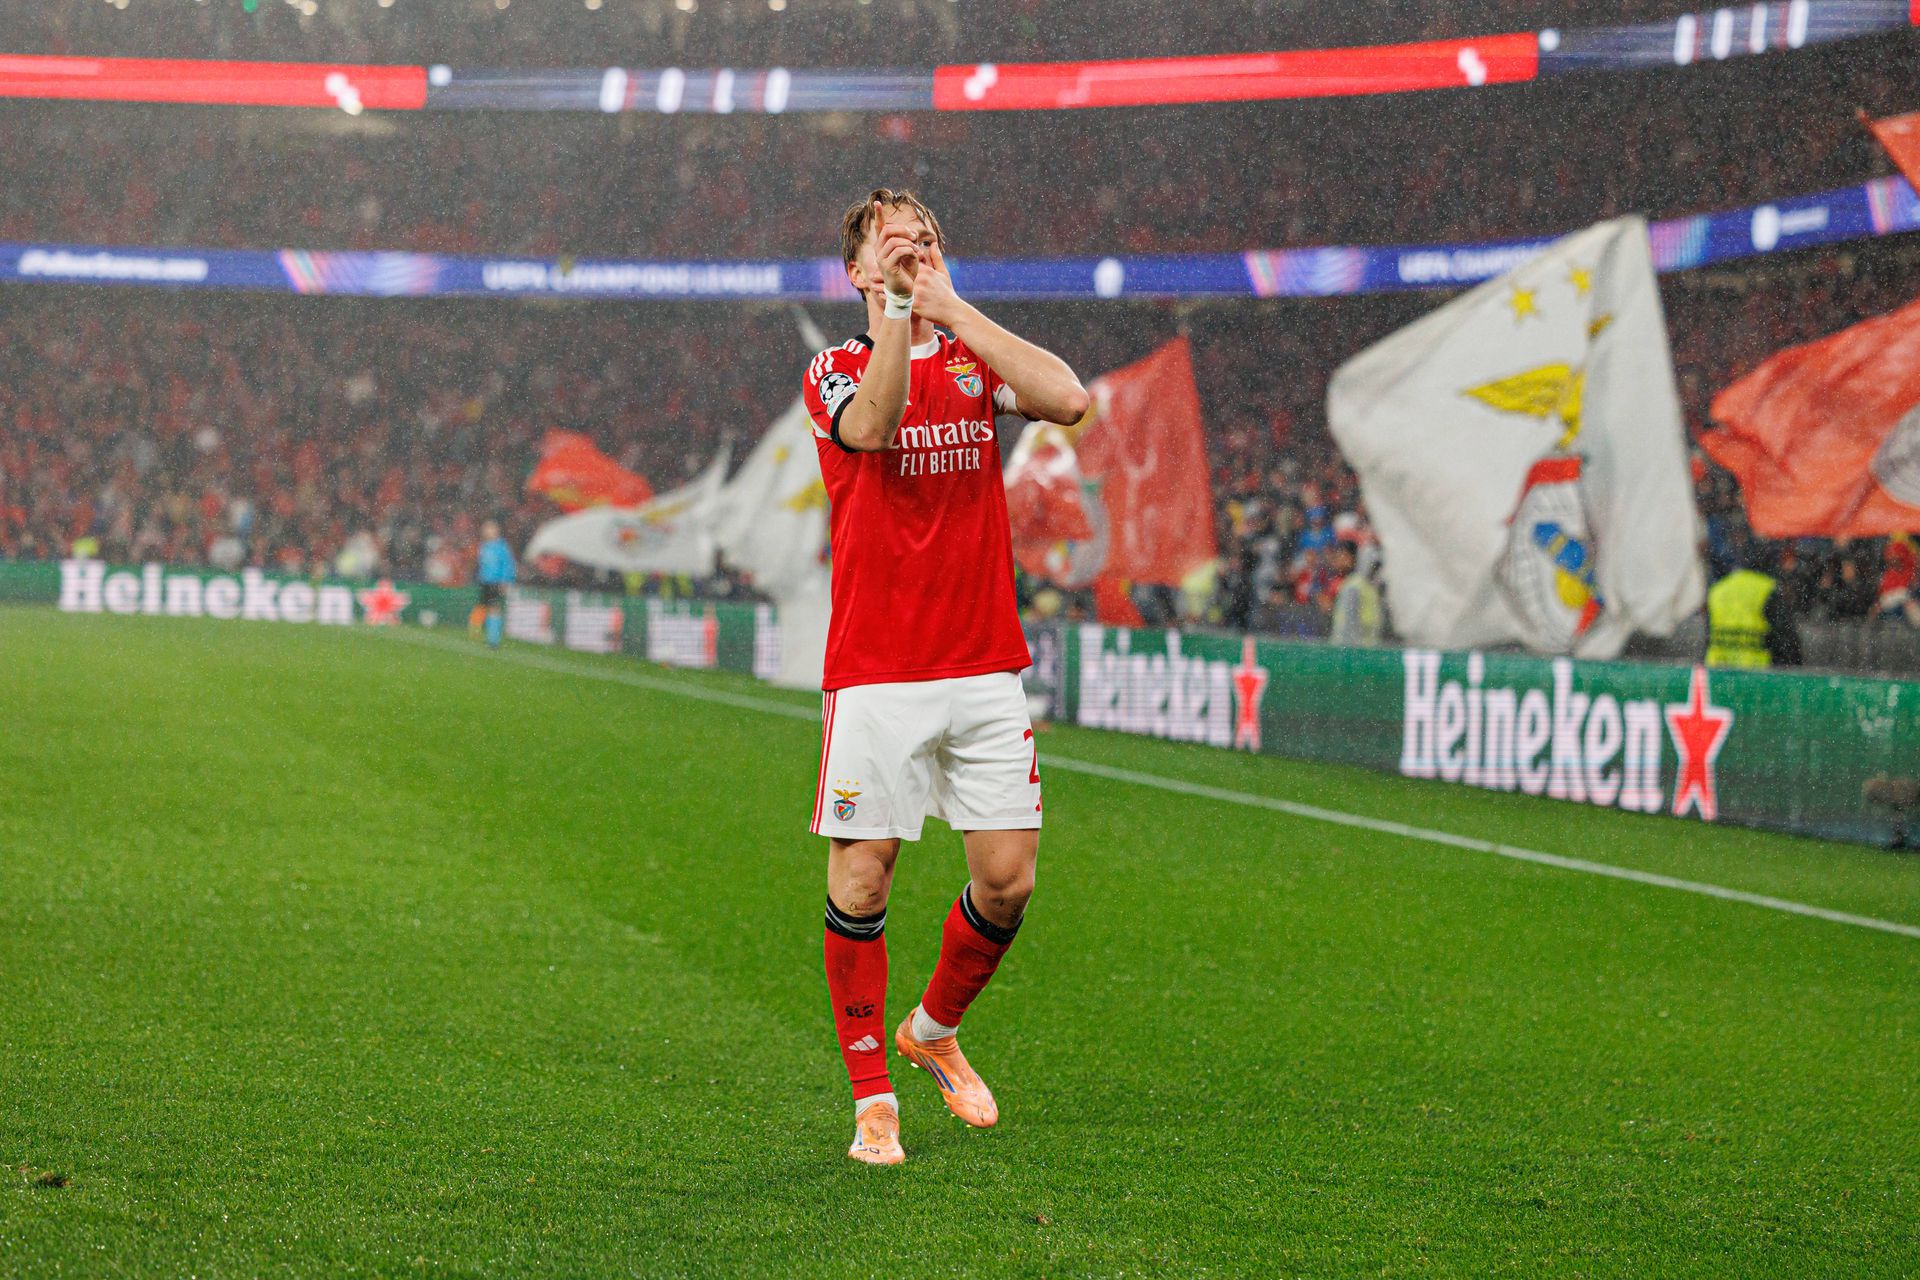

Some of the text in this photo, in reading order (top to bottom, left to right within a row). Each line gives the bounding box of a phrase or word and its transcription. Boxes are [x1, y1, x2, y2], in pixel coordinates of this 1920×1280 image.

[893, 417, 994, 449] mirates
[900, 447, 980, 477] FLY BETTER
[58, 558, 353, 625] Heineken
[1399, 649, 1664, 814] Heineken
